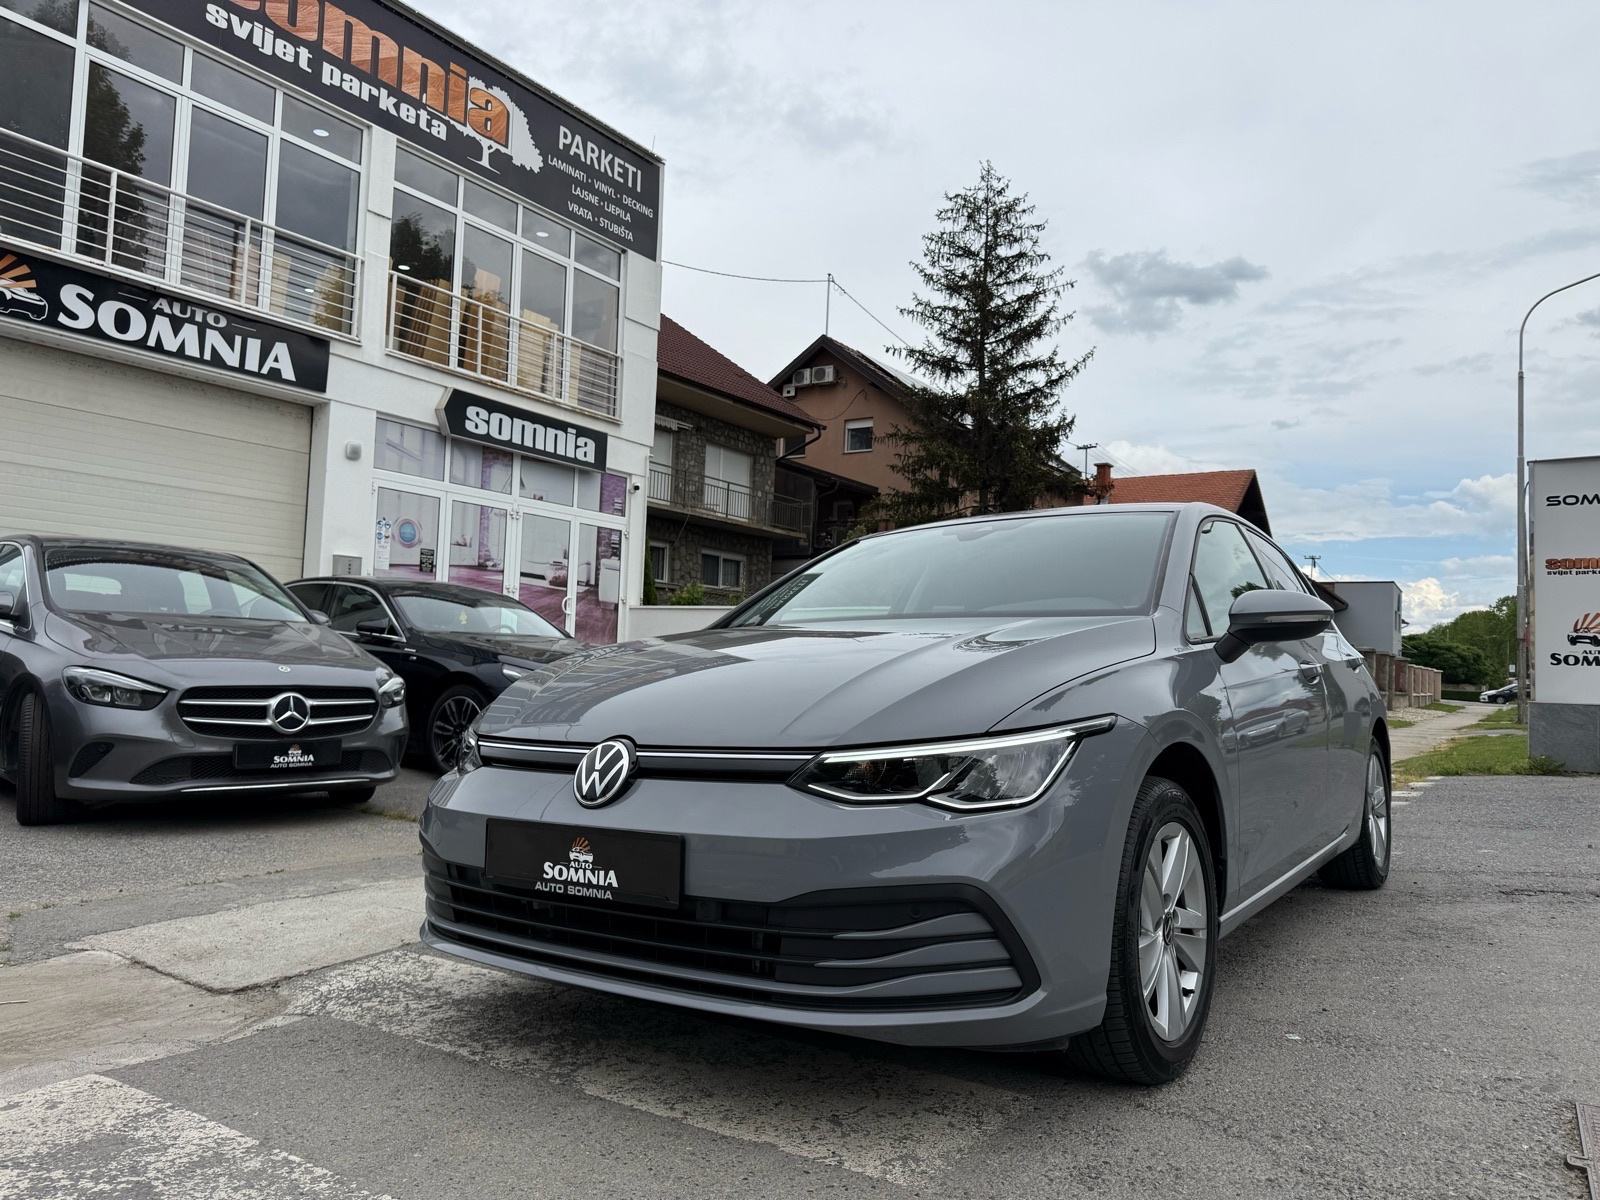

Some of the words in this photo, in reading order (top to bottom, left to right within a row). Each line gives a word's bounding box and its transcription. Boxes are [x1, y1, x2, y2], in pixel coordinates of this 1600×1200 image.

[205, 3, 313, 73] svijet
[321, 61, 448, 142] parketa
[558, 125, 642, 192] PARKETI
[547, 154, 587, 183] LAMINATI
[593, 178, 616, 198] VINYL
[622, 194, 654, 218] DECKING
[571, 184, 600, 206] LAJSNE
[604, 201, 632, 222] LJEPILA
[567, 200, 593, 221] VRATA
[599, 217, 634, 241] STUBIŠTA
[57, 283, 297, 382] SOMNIA
[152, 297, 228, 329] AUTO
[464, 405, 596, 463] somnia
[273, 754, 314, 763] SOMNIA
[543, 861, 619, 888] SOMNIA
[569, 861, 593, 870] AUTO
[534, 881, 564, 894] AUTO
[567, 885, 613, 900] SOMNIA
